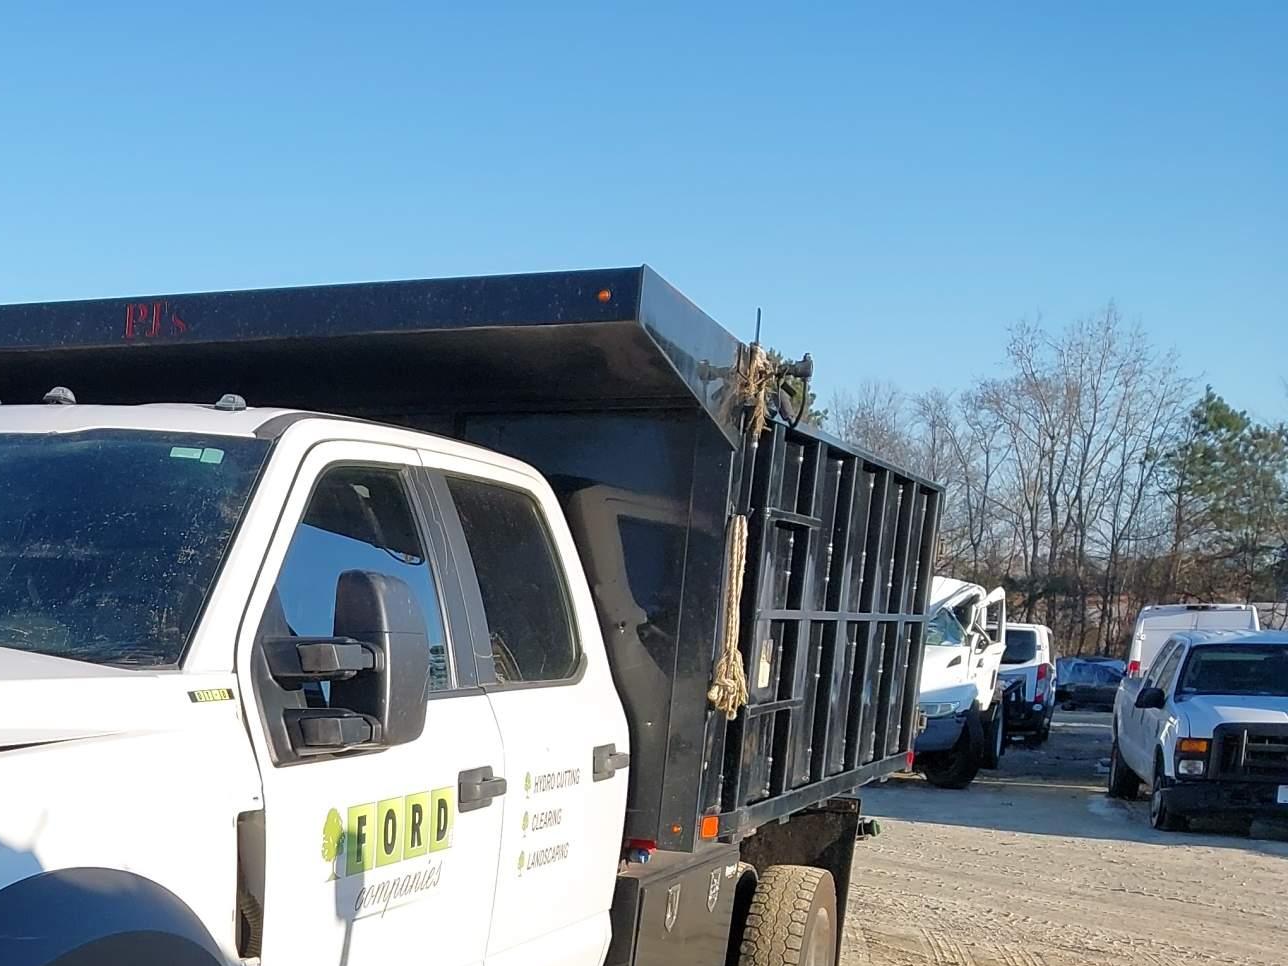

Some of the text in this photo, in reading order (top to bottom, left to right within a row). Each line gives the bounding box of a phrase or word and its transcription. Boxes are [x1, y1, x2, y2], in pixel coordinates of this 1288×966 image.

[534, 772, 556, 793] HYDRO
[356, 798, 448, 863] FORD
[527, 842, 569, 870] LANDSCAPING
[354, 858, 443, 918] companies
